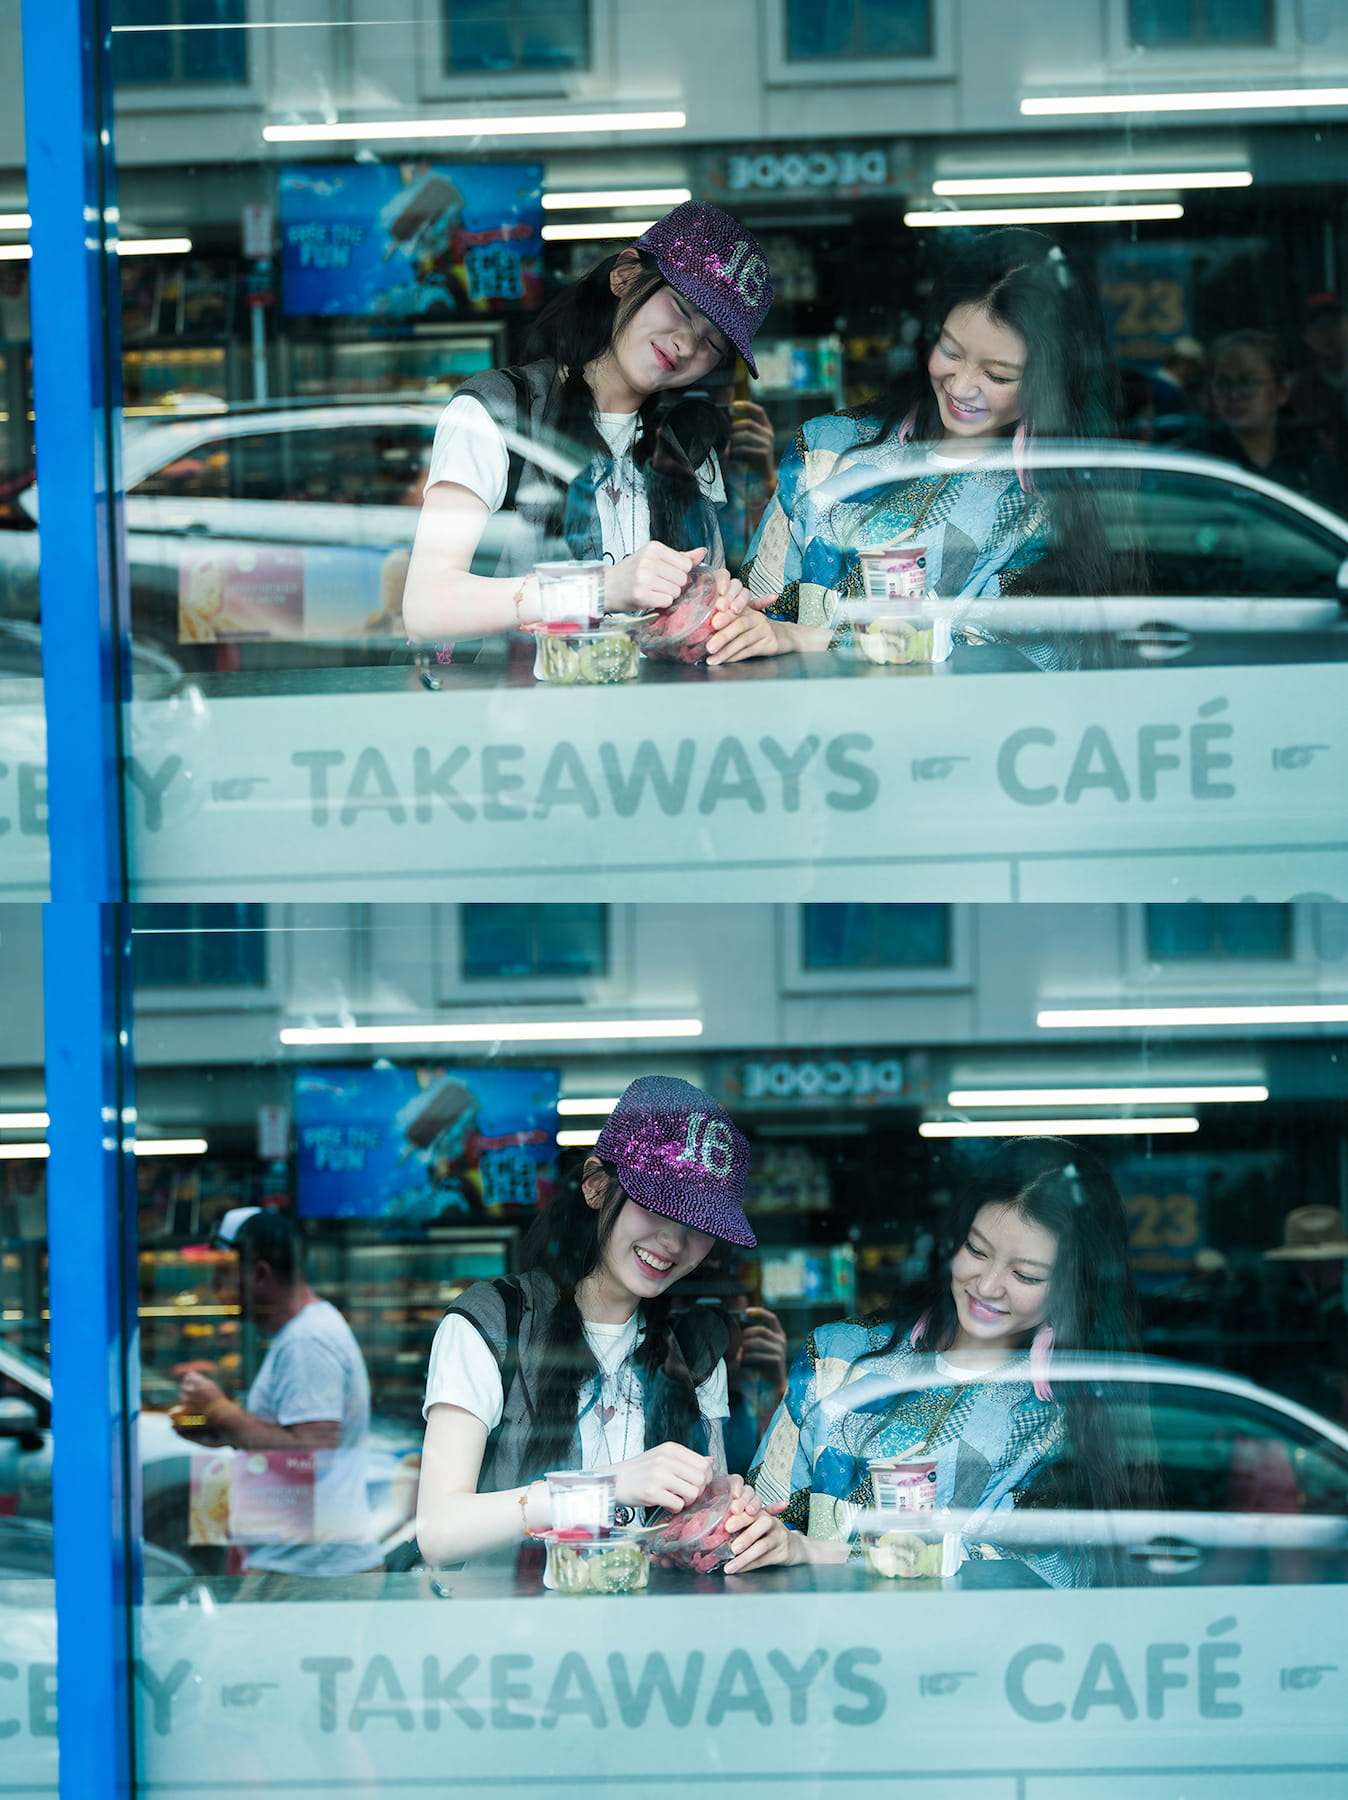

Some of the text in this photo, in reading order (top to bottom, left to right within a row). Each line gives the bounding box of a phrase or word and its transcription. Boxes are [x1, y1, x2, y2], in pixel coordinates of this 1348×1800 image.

[300, 245, 349, 269] FUN
[716, 240, 767, 308] 16
[291, 732, 879, 827] TAKEAWAYS
[996, 697, 1236, 806] CAFÉ
[315, 1147, 364, 1172] FUN
[676, 1112, 733, 1178] 16
[300, 1646, 888, 1735] TAKEAWAYS
[1003, 1615, 1244, 1723] CAFÉ
